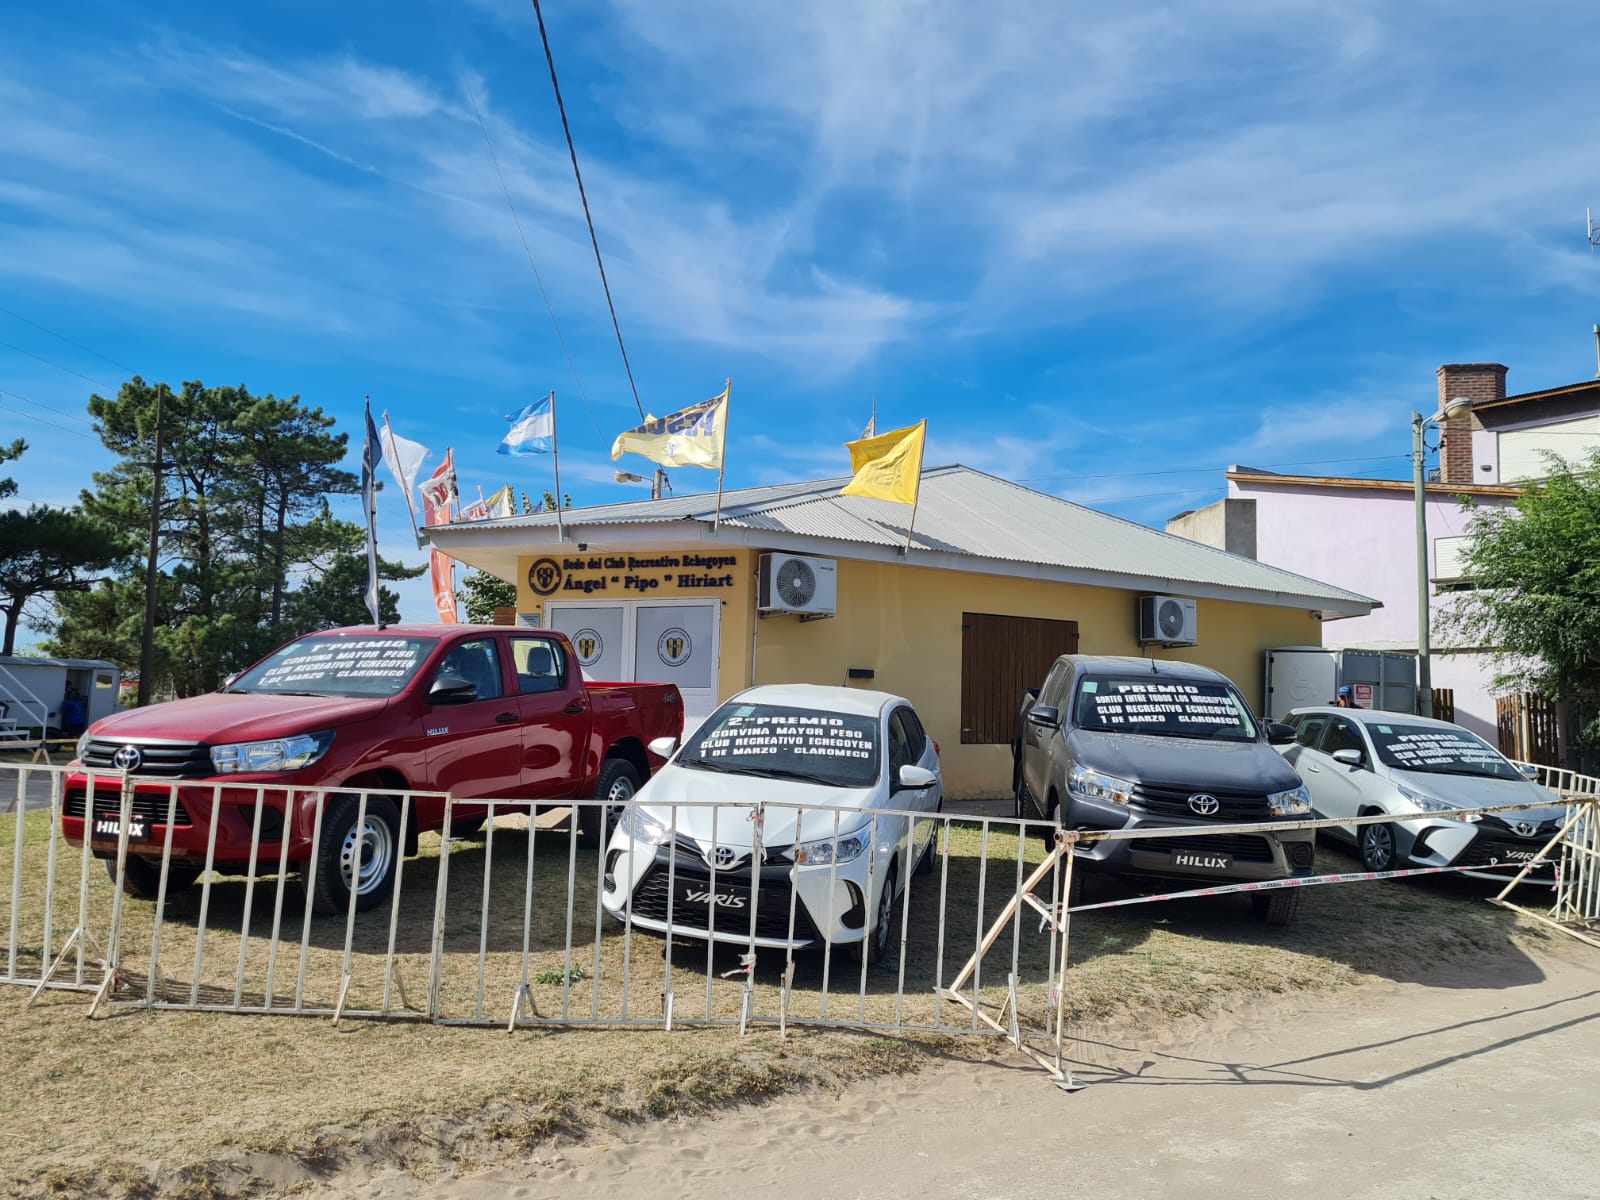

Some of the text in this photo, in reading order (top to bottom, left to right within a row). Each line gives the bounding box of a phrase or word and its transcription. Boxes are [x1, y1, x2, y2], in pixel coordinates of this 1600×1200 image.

[563, 554, 737, 571] Sede del Club Recreativo Echegoyen
[563, 574, 607, 593] Ángel
[624, 575, 659, 592] Pipo
[677, 574, 734, 588] Hiriart
[328, 640, 408, 651] PREMIO
[281, 650, 416, 666] CORVINA MAYOR PESO
[293, 660, 356, 673] RECREATIVO
[335, 669, 406, 678] CLAROMECO
[1118, 685, 1199, 694] PREMIO
[1097, 704, 1239, 716] CLUB RECREATIVO ECHEGOYEN
[757, 717, 844, 726] PREMIO
[1100, 715, 1241, 725] 1 DE MARZO CLAROMECO
[711, 727, 863, 739] CORVINA MAYOR PESO
[1397, 734, 1460, 742] PREMIO
[700, 736, 873, 750] CLUB RECREATIVO ECHEGOYEN
[700, 749, 706, 758] 1
[712, 748, 728, 757] DE
[732, 746, 778, 756] MARZO
[793, 747, 869, 759] CLAROMECO
[1176, 855, 1228, 869] HILUX
[685, 889, 747, 908] YARIS
